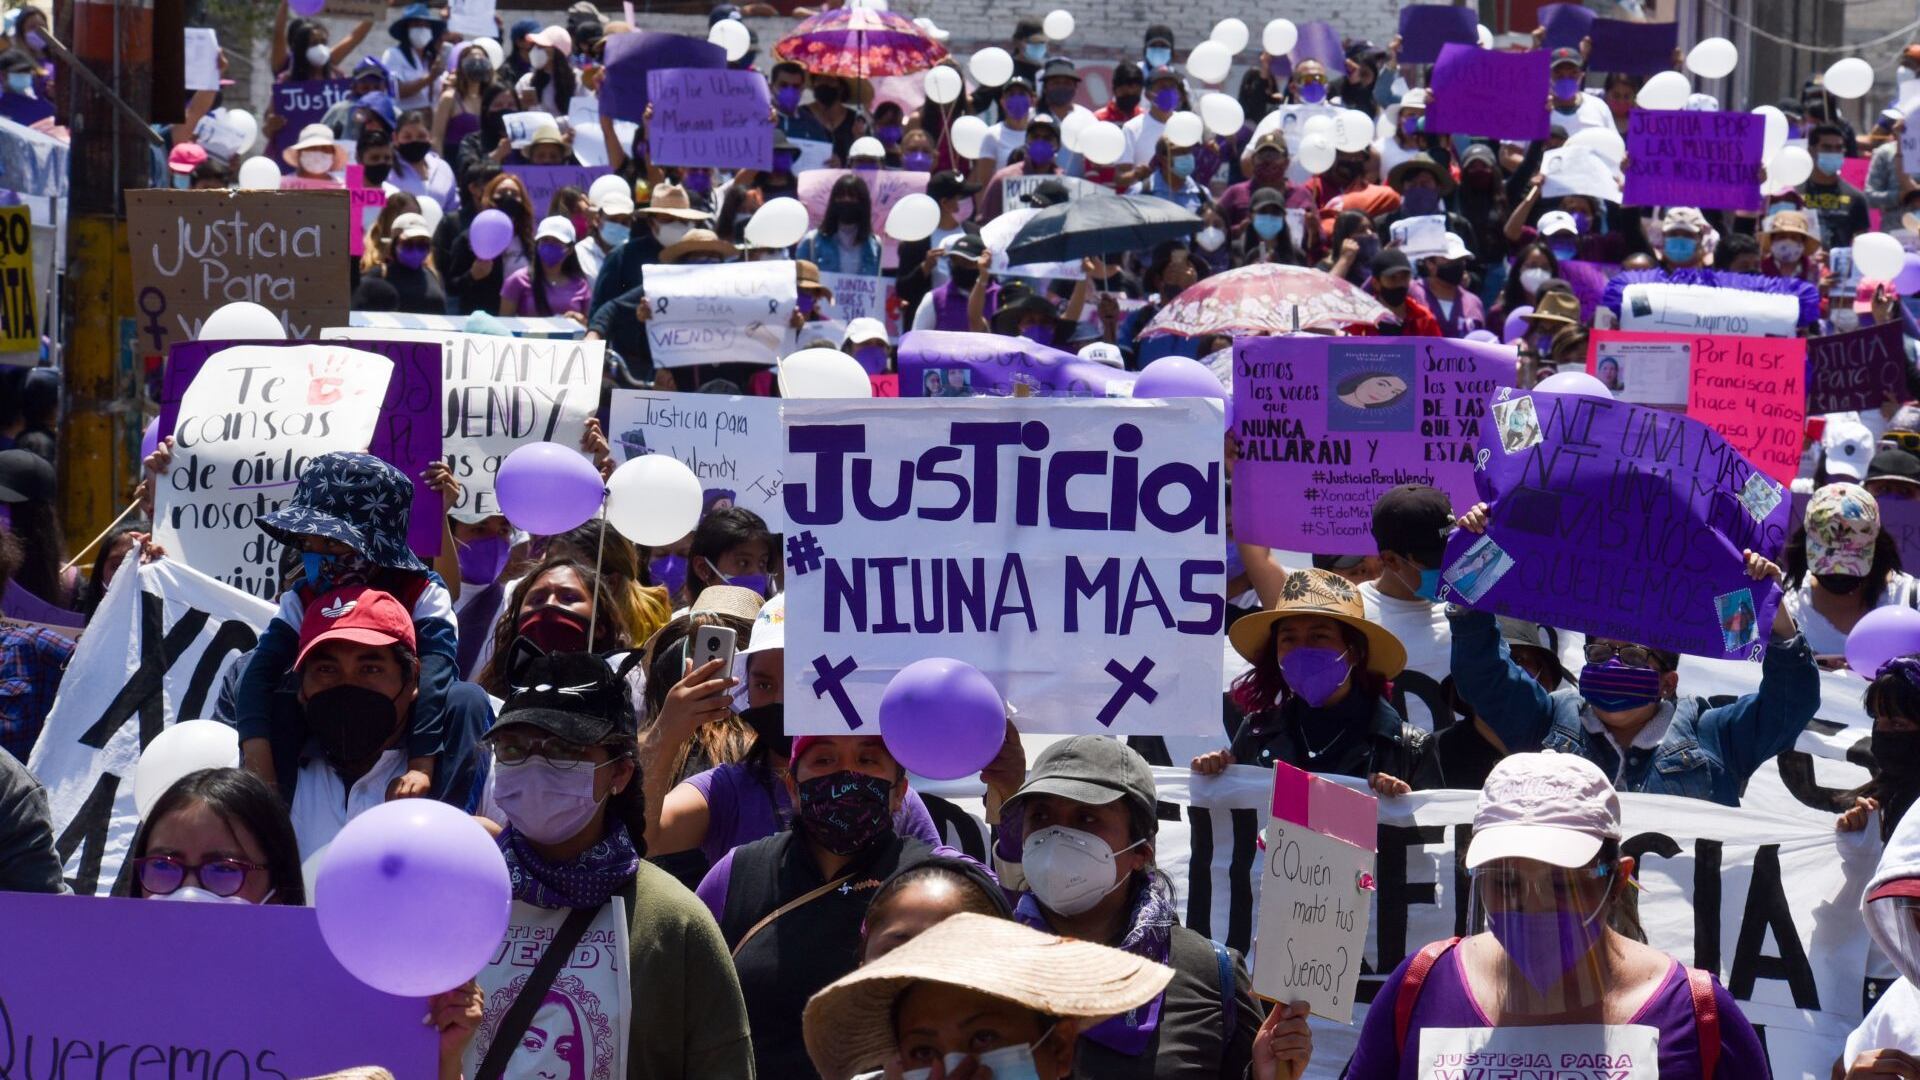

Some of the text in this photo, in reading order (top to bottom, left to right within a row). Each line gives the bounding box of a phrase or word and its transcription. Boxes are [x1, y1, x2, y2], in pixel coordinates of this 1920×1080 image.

[281, 85, 352, 111] Justic
[1713, 115, 1752, 139] POR
[1645, 138, 1677, 158] LAS
[352, 190, 386, 205] NDY
[152, 210, 321, 277] Justicia
[200, 258, 295, 304] Para
[650, 326, 729, 349] WENDY
[1695, 338, 1726, 364] Por
[1736, 341, 1754, 366] la
[1237, 349, 1294, 381] Somos
[1422, 344, 1478, 374] Somos
[227, 365, 286, 405] Te
[1250, 383, 1320, 401] las voces
[1424, 375, 1498, 395] las voces
[633, 395, 749, 448] Justicia para
[1262, 402, 1288, 420] que
[1423, 398, 1486, 418] DE LAS
[1693, 391, 1804, 422] hace 4 años
[175, 409, 335, 449] cansas
[1241, 418, 1306, 440] NUNCA
[1420, 418, 1480, 439] QUE YA
[1543, 397, 1613, 448] NI
[1619, 407, 1687, 466] UNA
[1756, 425, 1768, 448] y
[1772, 425, 1796, 447] no
[1367, 439, 1379, 464] Y
[171, 454, 217, 493] de
[783, 420, 1220, 535] Justicia
[1311, 468, 1435, 487] #JusticiaParaWendy
[1519, 441, 1599, 498] NI
[1608, 458, 1673, 524] UNA
[243, 533, 280, 566] de
[1632, 514, 1715, 573] NOS
[1063, 554, 1226, 636] MAS
[1518, 549, 1719, 626] QUEREMOS
[832, 782, 859, 799] Love
[1271, 828, 1331, 886] ¿Quién
[1293, 893, 1354, 933] mató tus
[1284, 937, 1349, 1007] Sueños?
[1433, 1053, 1633, 1069] JUSTICIA PARA
